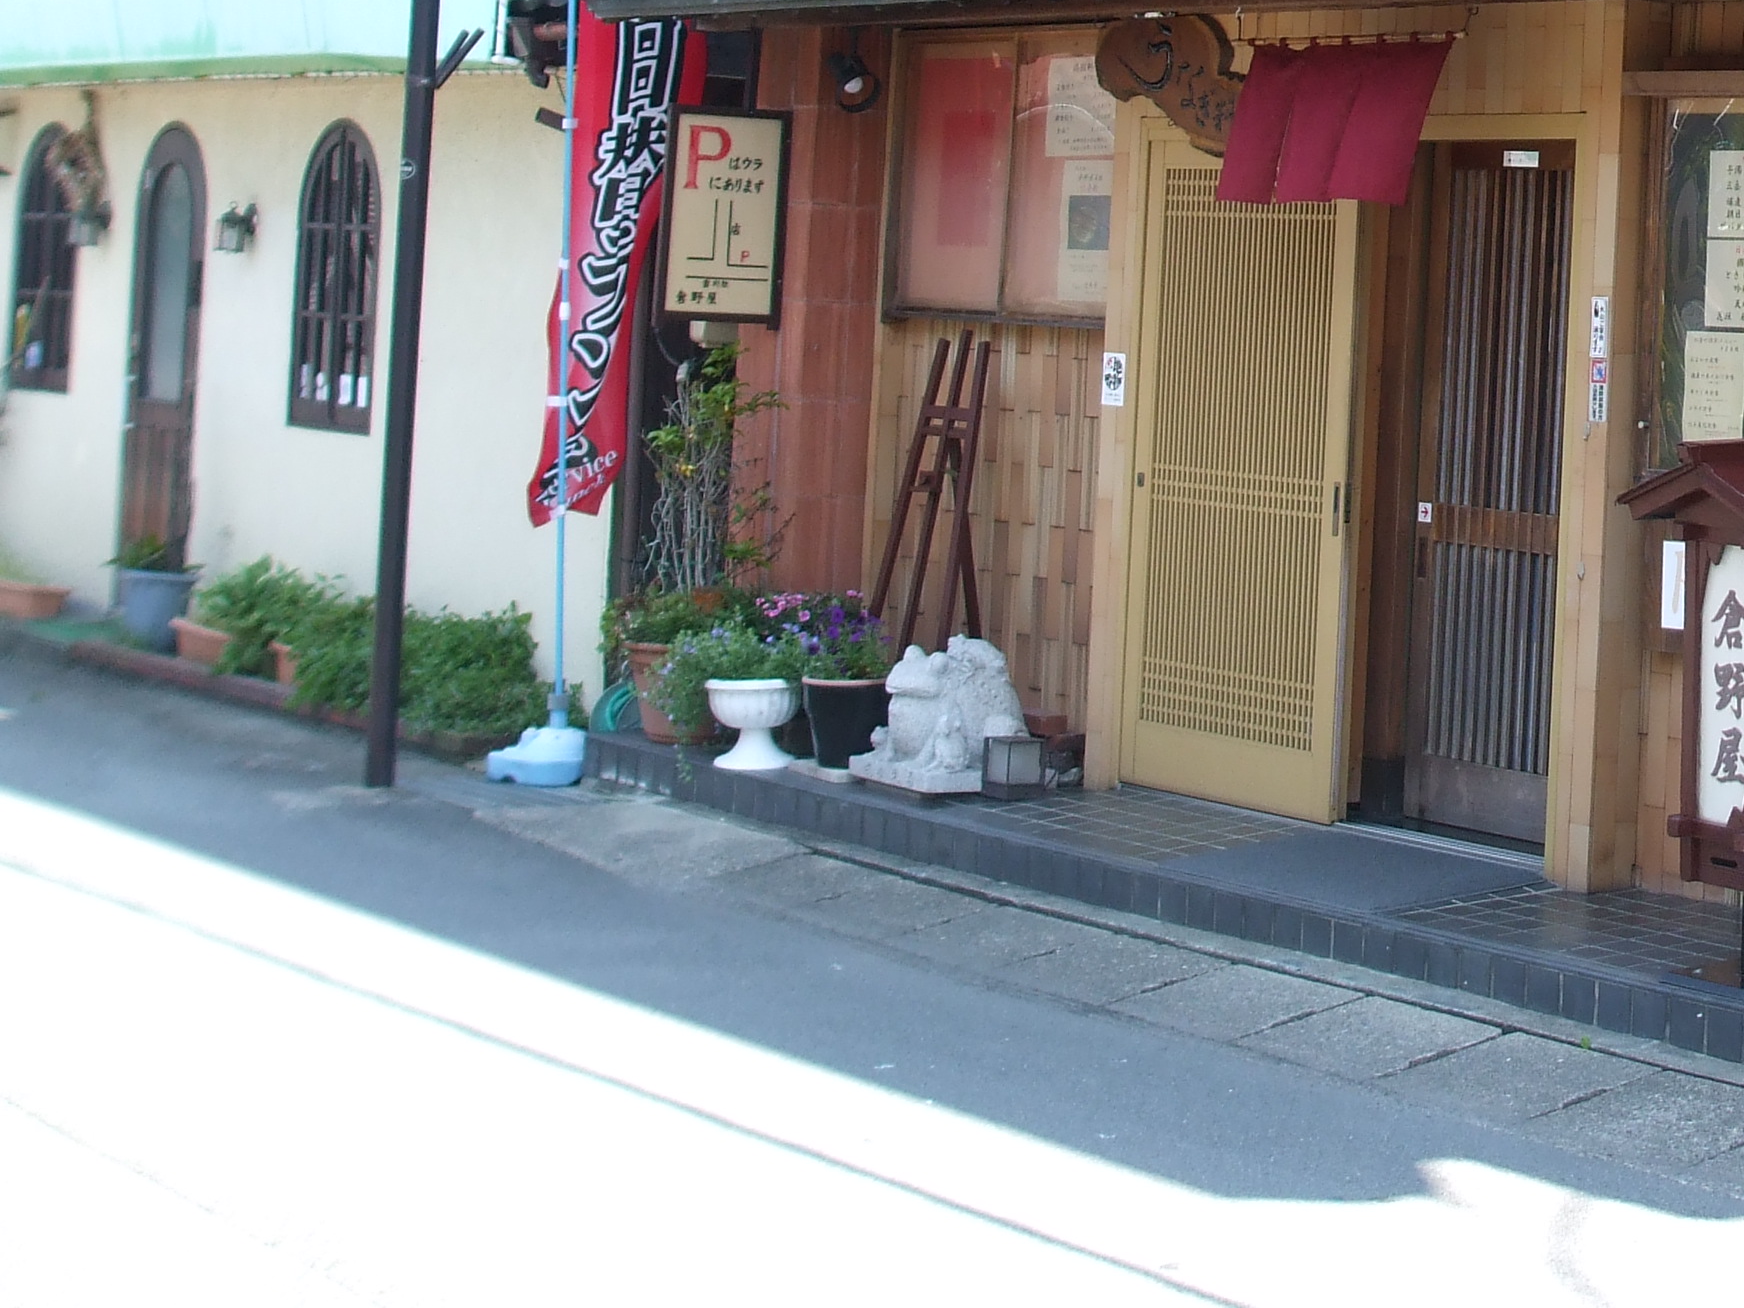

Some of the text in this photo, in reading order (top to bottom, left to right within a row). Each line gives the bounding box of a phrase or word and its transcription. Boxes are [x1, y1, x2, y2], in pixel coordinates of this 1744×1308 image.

[684, 125, 732, 189] P
[729, 157, 763, 172] はウラ
[709, 176, 764, 194] にあります
[740, 250, 750, 263] P
